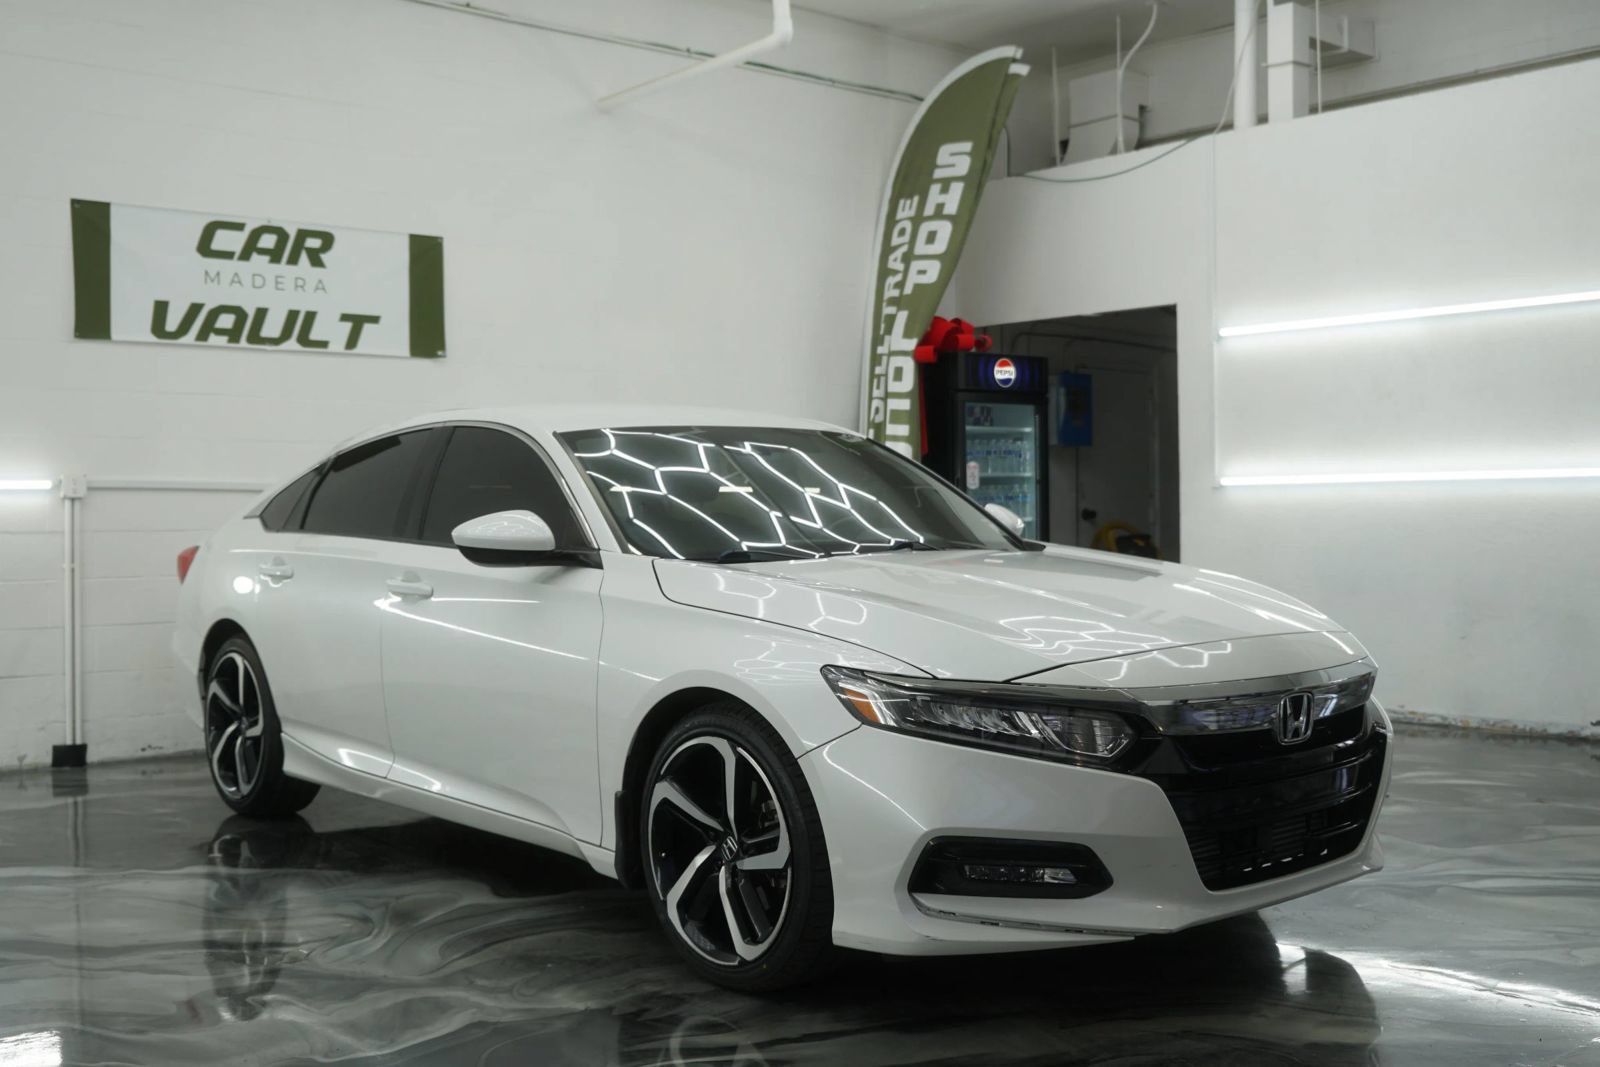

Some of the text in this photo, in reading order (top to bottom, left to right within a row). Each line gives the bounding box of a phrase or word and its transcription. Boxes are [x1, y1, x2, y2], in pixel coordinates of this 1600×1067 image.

[903, 141, 973, 295] SHOP
[196, 220, 335, 269] CAR
[881, 195, 919, 325] TRADE
[204, 270, 328, 294] MADERA
[150, 300, 382, 351] VAULT
